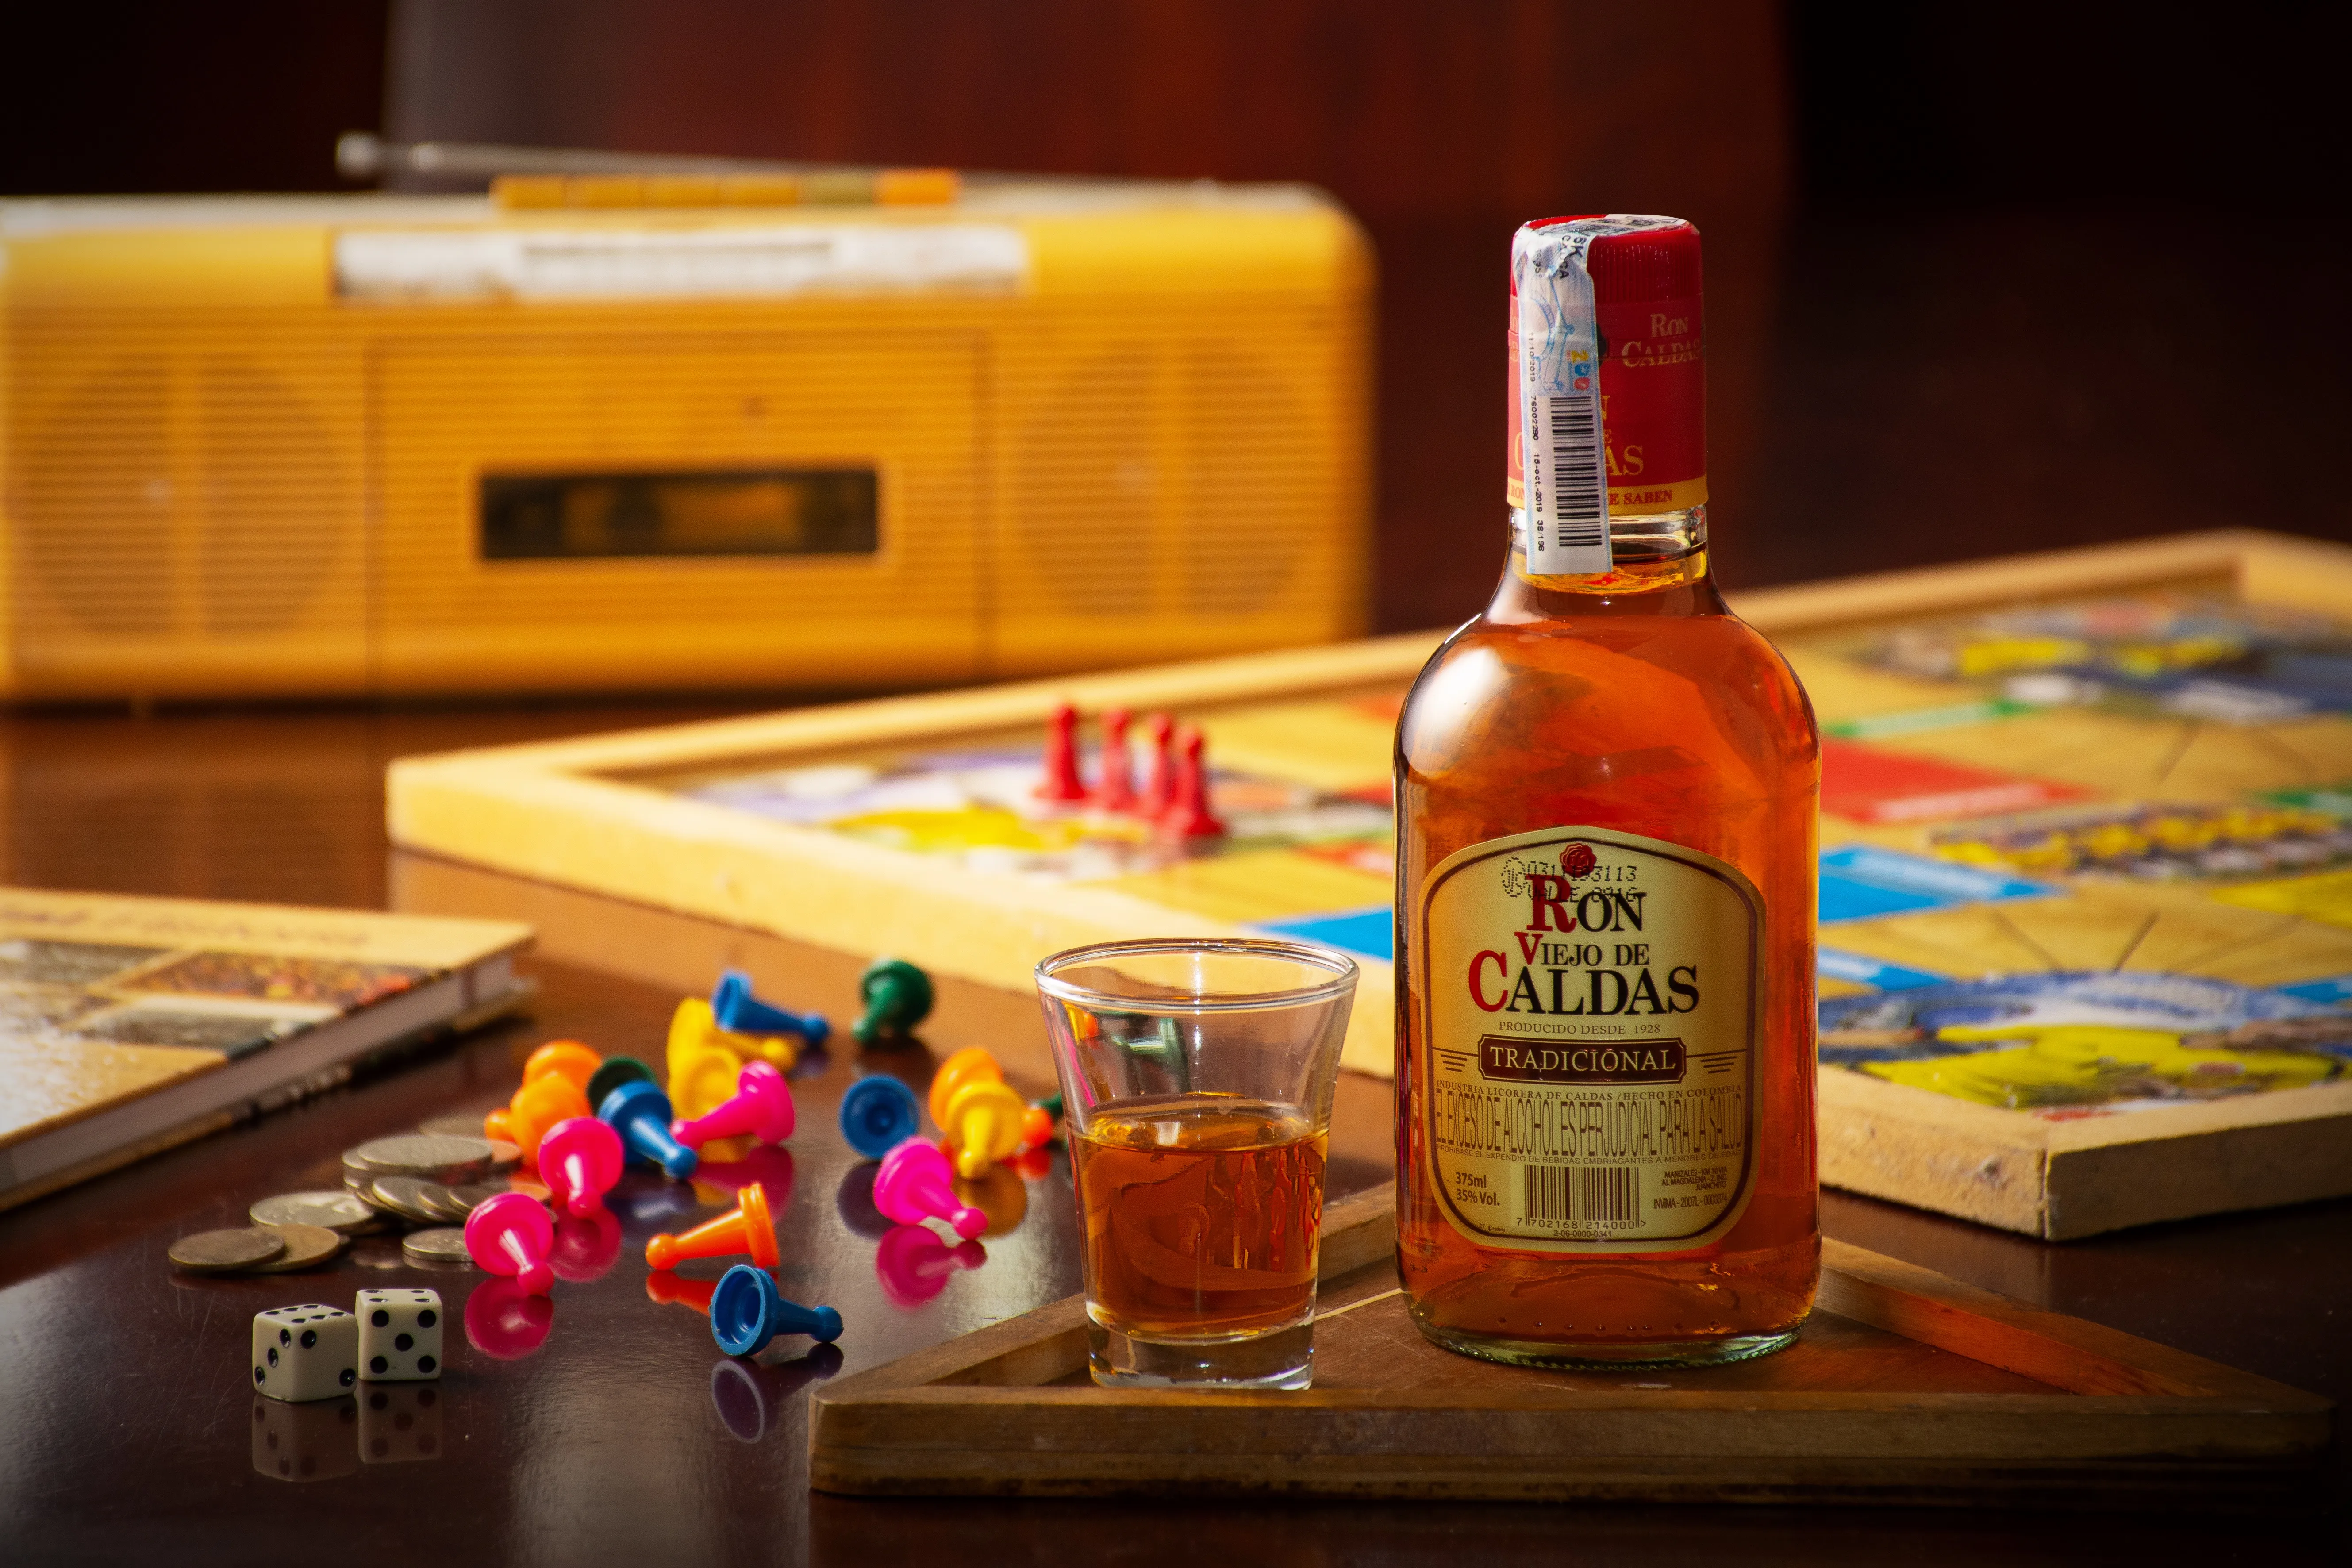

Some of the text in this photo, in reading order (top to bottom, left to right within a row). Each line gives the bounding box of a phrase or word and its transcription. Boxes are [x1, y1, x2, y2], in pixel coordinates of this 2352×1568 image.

[1650, 314, 1688, 337] RON
[1622, 338, 1701, 367] CALDAS
[1624, 490, 1672, 505] SABEN
[1514, 932, 1649, 966] VIEJO DE
[1468, 950, 1700, 1015] CALDAS
[1499, 1021, 1660, 1034] PRODUCIDO DESDE 1928
[1490, 1046, 1676, 1072] TRADICIONAL
[1437, 1079, 1483, 1093] INDUSTRIA
[1486, 1087, 1543, 1099] LICORERA
[1547, 1091, 1562, 1100] DE
[1565, 1091, 1613, 1101] CALDAS
[1669, 1090, 1683, 1099] EN
[1687, 1084, 1742, 1099] COLOMBIA
[1437, 1088, 1742, 1156] EL EXCESO DE ALCOHOL ES PERJUDICIAL PARA LA SALUD
[1486, 1152, 1526, 1161] EXPENDIO
[1542, 1156, 1580, 1164] BEBIDAS
[1583, 1156, 1653, 1164] EMBRIAGANTES
[1664, 1152, 1705, 1163] MENORES
[1455, 1172, 1486, 1188] 375ml
[1456, 1189, 1499, 1206] 35% Vol.
[1516, 1218, 1522, 1226] 7
[1530, 1219, 1578, 1228] 702168
[1586, 1220, 1635, 1229] 214000
